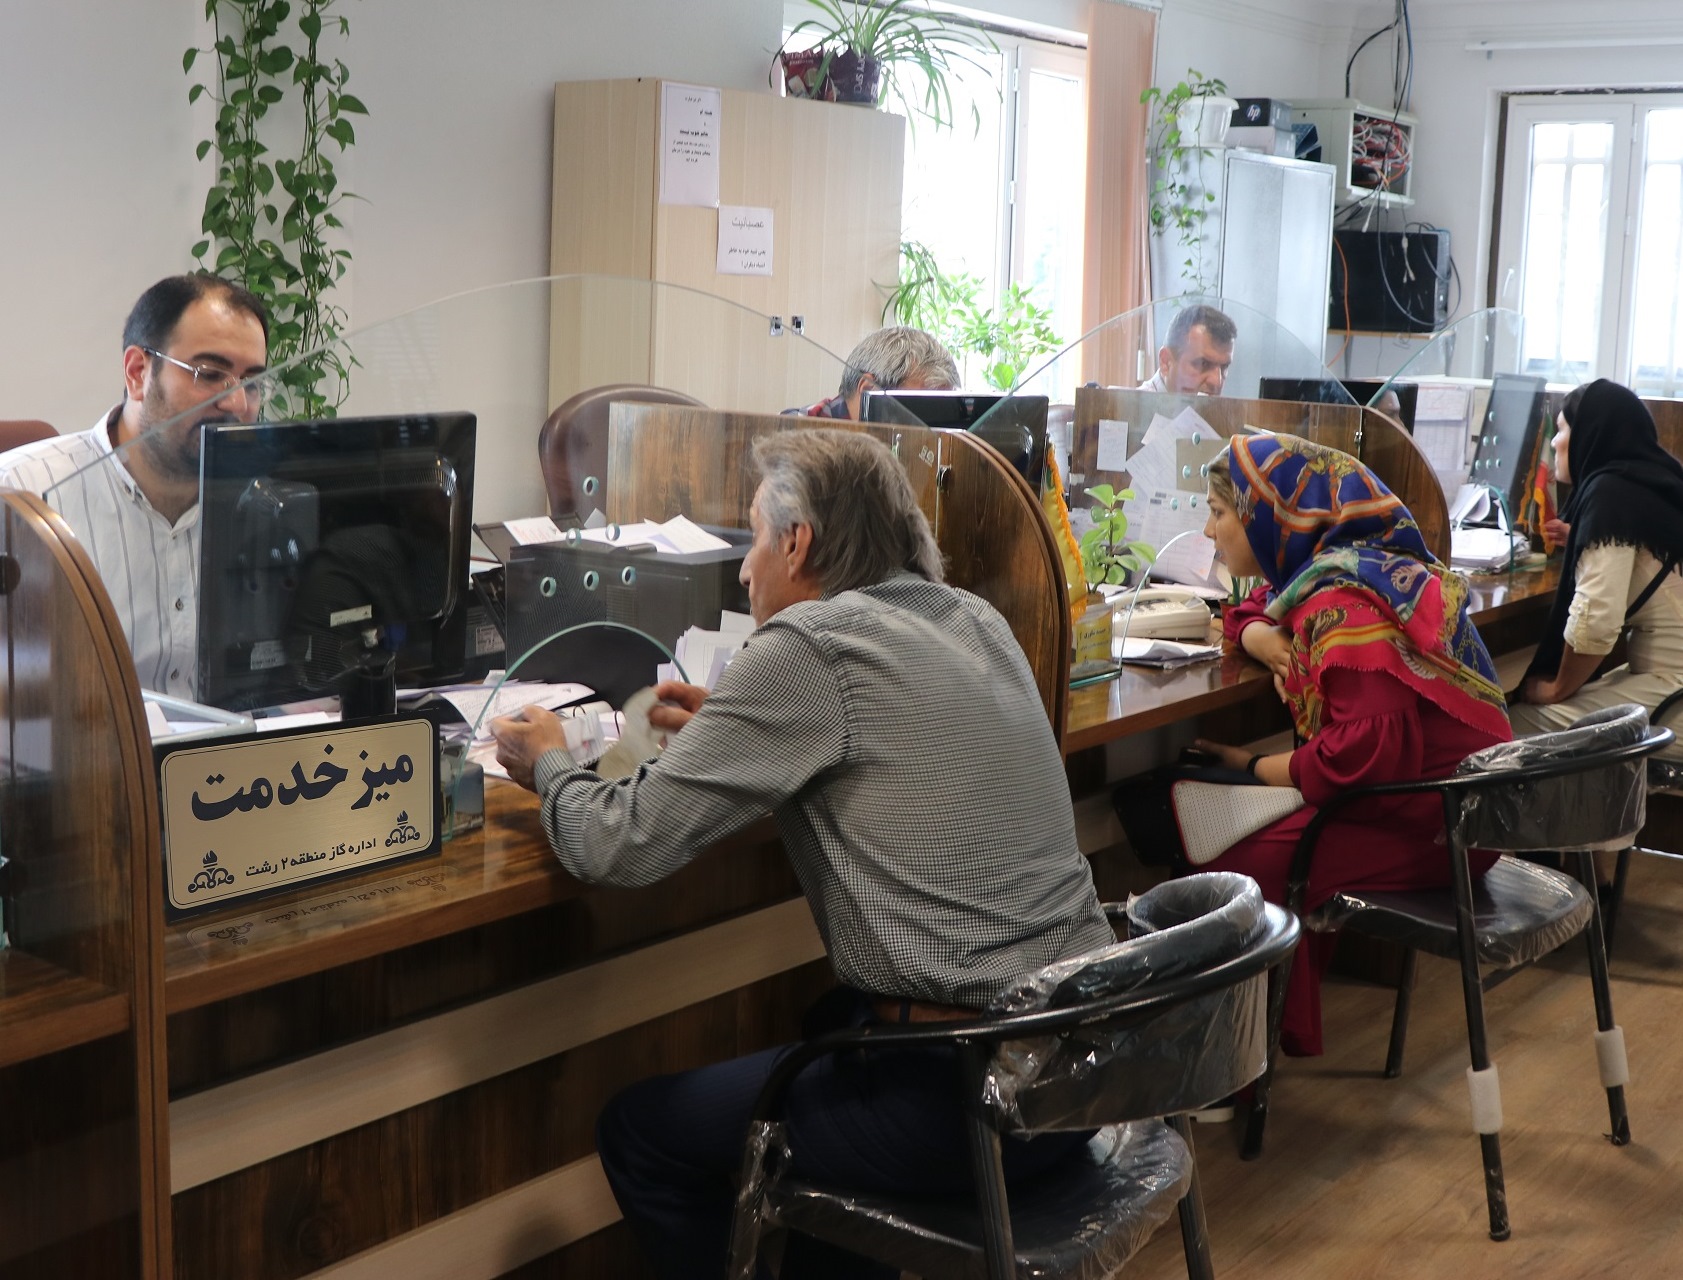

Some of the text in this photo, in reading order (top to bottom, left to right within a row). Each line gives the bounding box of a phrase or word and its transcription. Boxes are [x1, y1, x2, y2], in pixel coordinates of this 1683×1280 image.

[1247, 104, 1261, 121] hp
[191, 743, 414, 821] میز خدمت
[329, 842, 346, 860] گاز
[348, 837, 377, 854] اداره
[290, 851, 326, 867] منطقه
[245, 860, 278, 877] رشت
